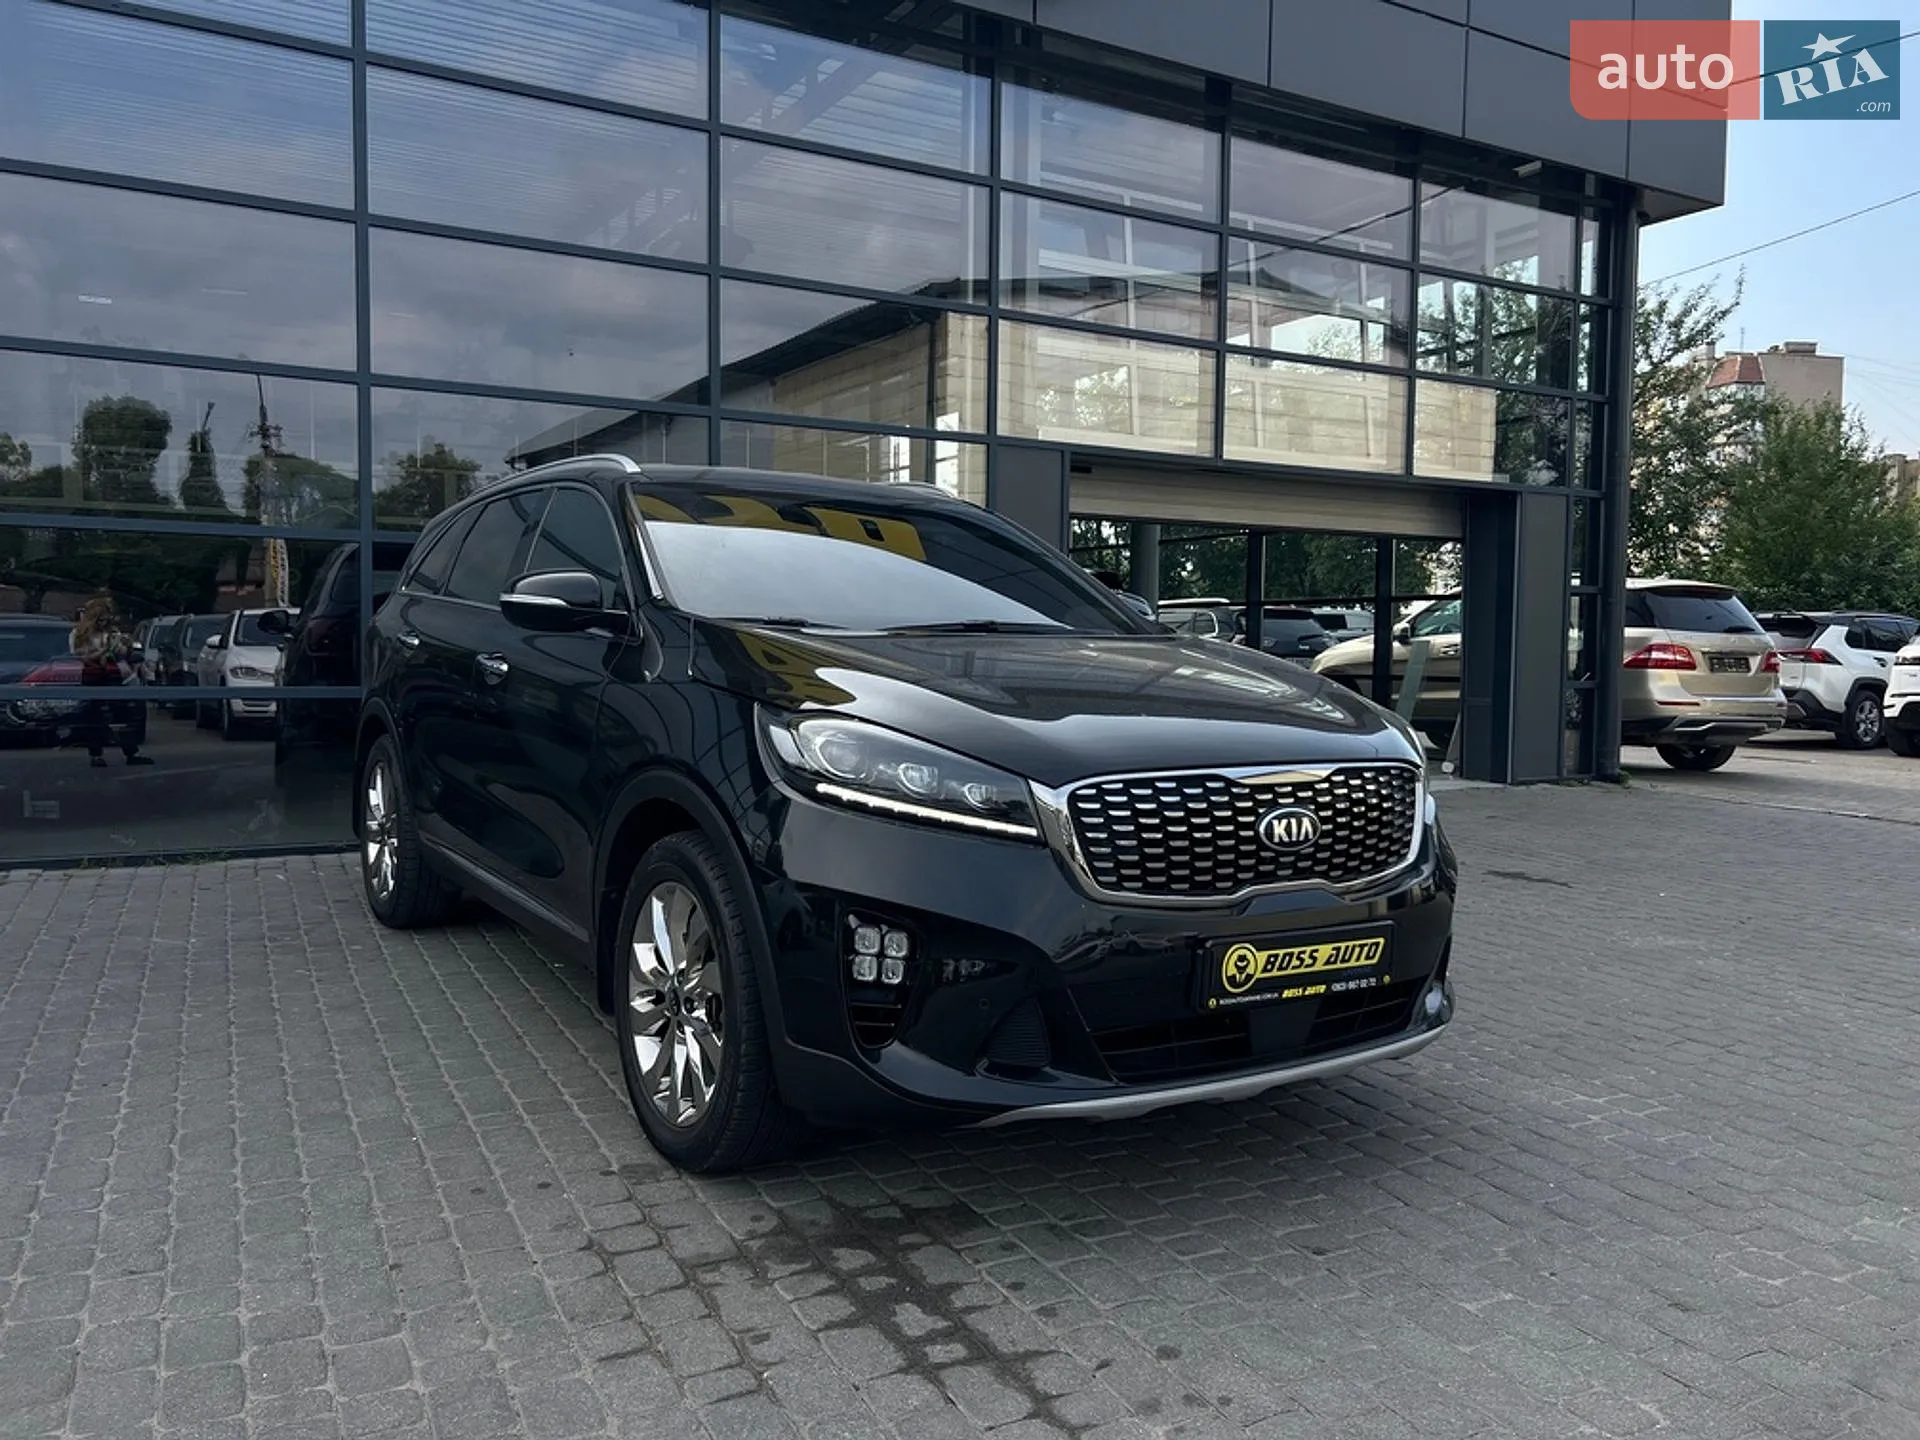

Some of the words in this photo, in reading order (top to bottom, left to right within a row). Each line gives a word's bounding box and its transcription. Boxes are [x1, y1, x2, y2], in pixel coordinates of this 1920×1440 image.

[1271, 816, 1314, 843] KIA
[1261, 949, 1320, 974] BOSS
[1322, 941, 1381, 967] AUTO
